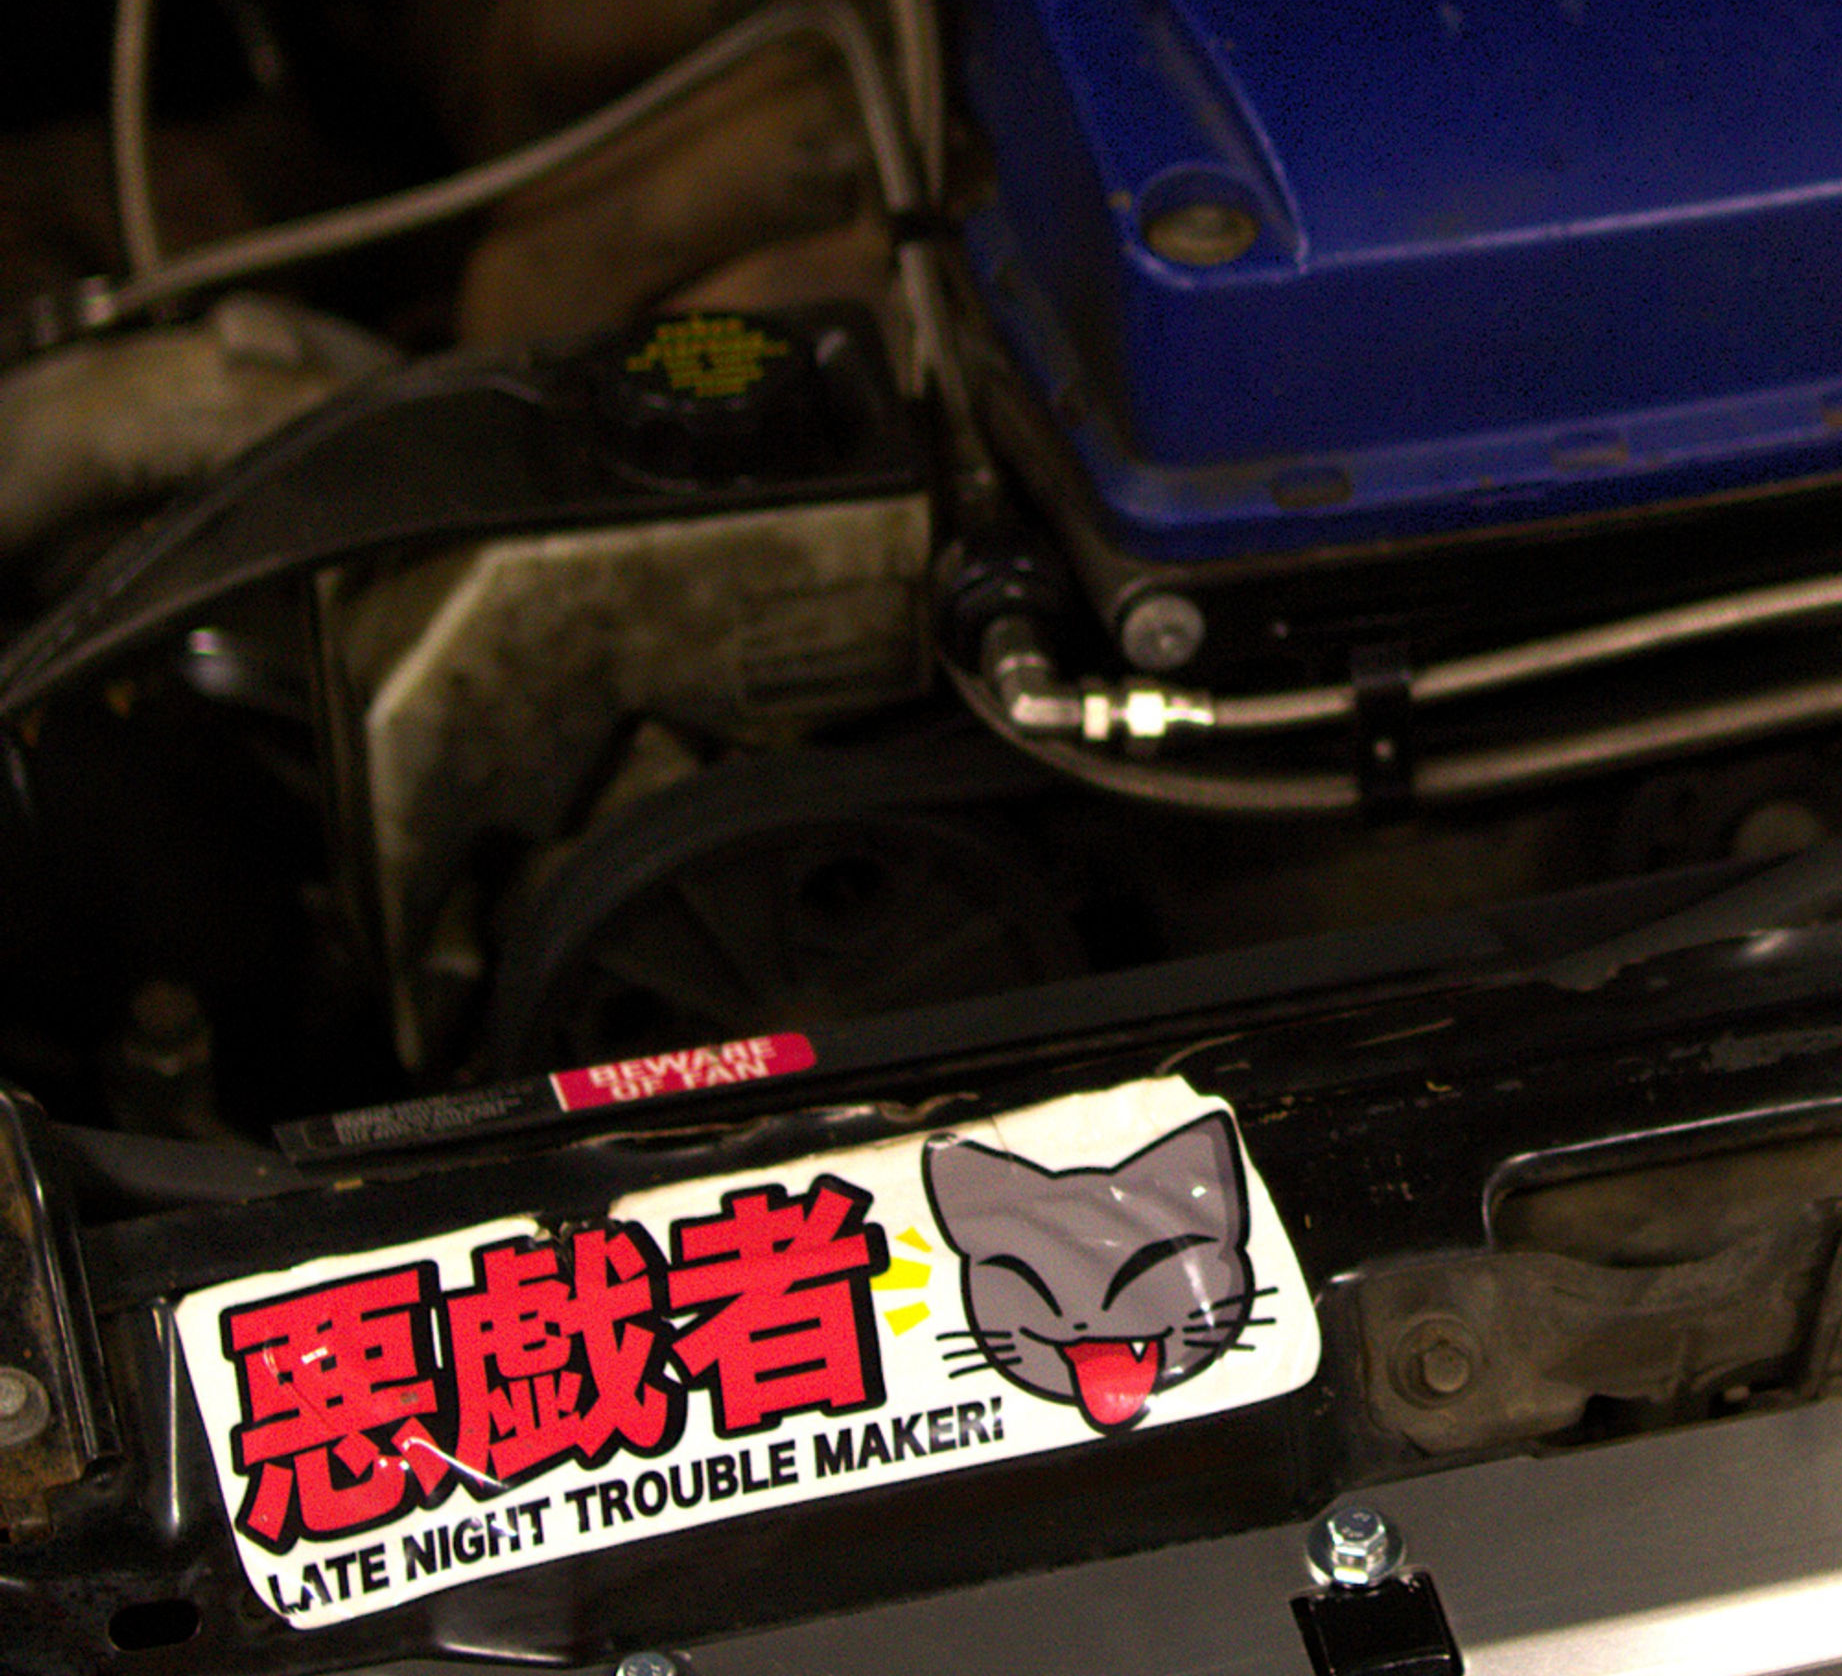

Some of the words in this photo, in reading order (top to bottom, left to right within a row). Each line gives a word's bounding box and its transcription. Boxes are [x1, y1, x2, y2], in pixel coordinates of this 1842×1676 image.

[588, 1035, 777, 1087] BEWARE
[611, 1074, 664, 1101] OF
[681, 1057, 769, 1090] FAN
[220, 1174, 890, 1554] 悪戯者
[268, 1543, 390, 1614] LATE
[402, 1497, 551, 1581] NIGHT
[564, 1440, 799, 1534] TROUBLE
[813, 1396, 1004, 1479] MAKER!
